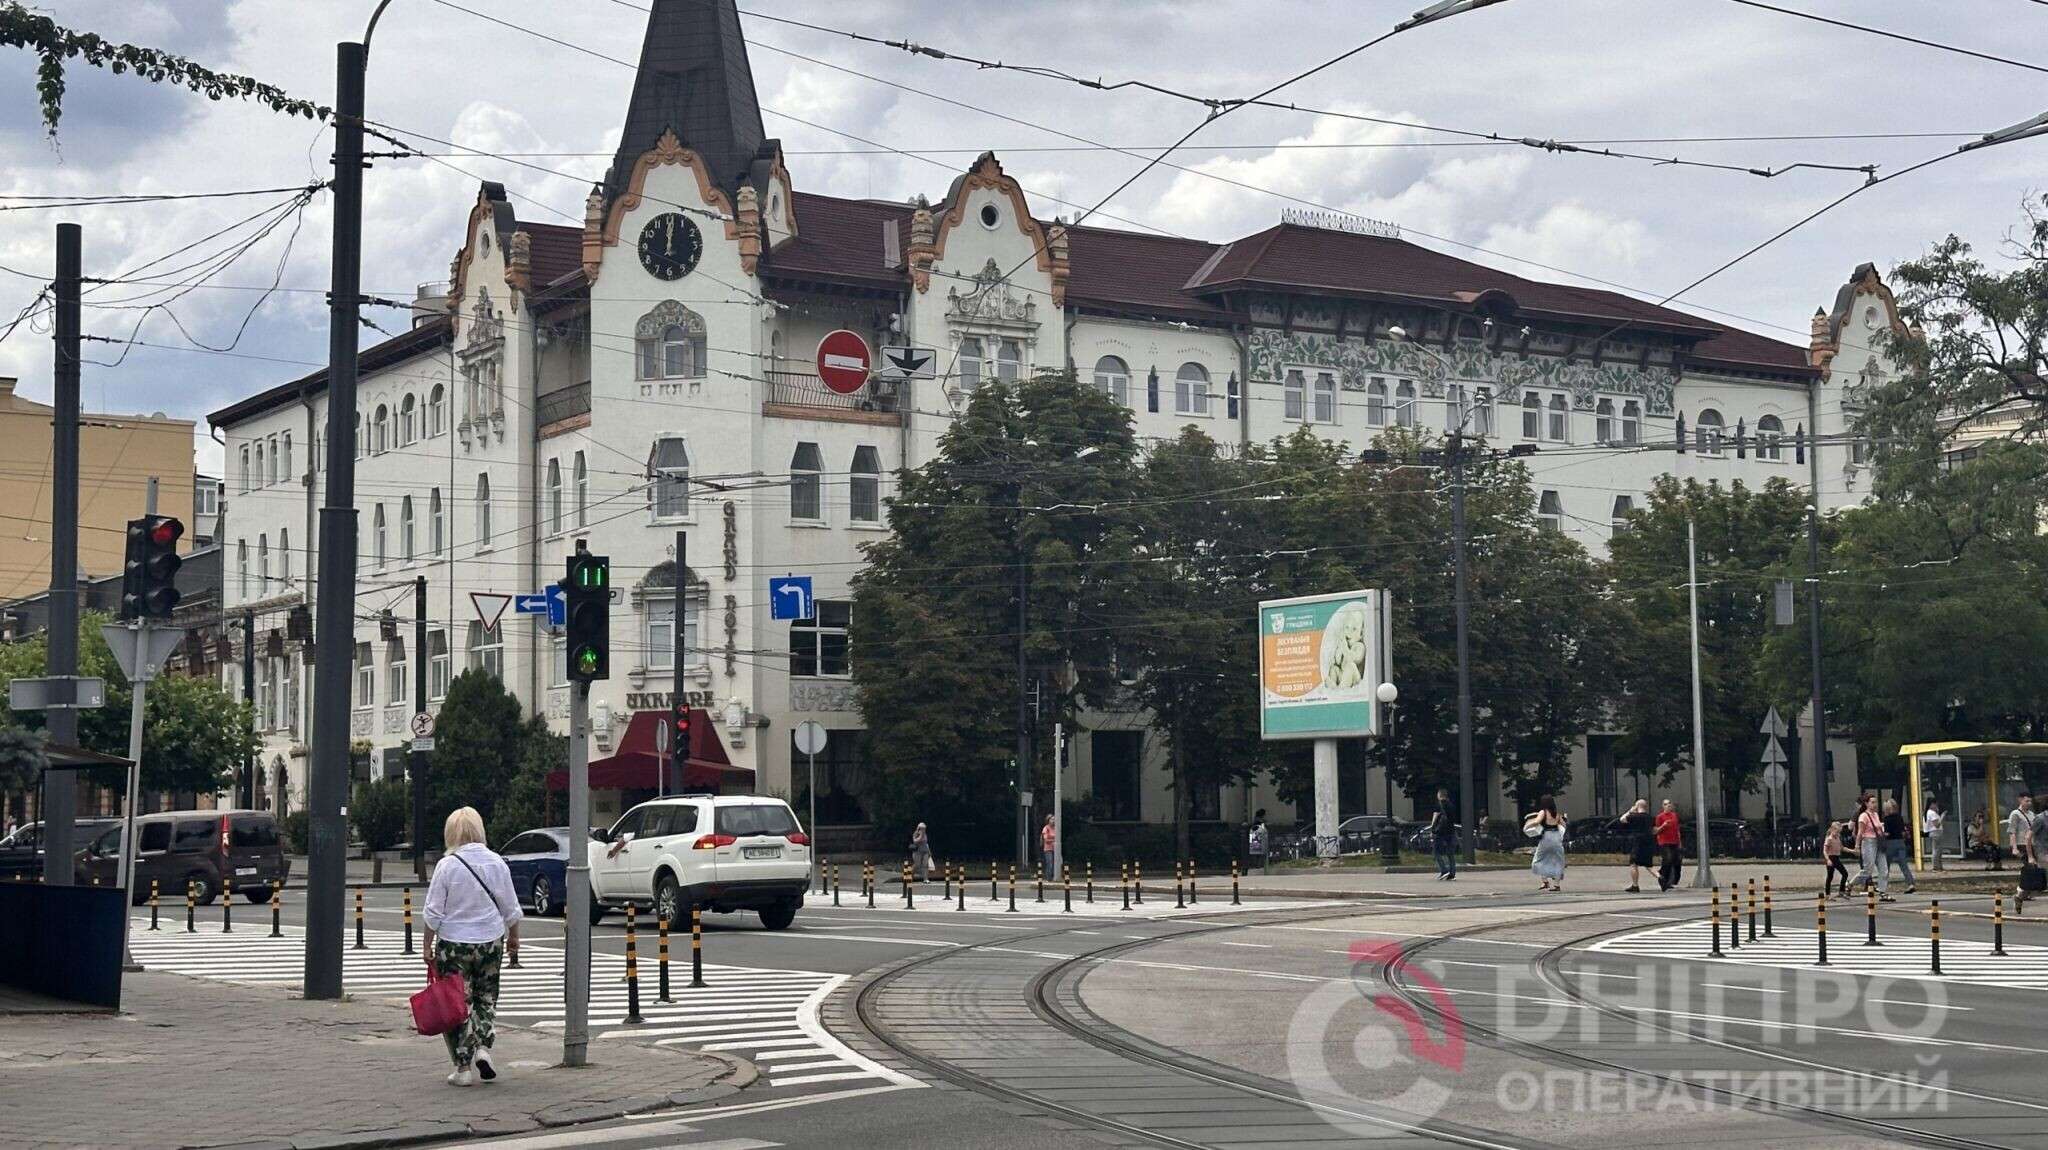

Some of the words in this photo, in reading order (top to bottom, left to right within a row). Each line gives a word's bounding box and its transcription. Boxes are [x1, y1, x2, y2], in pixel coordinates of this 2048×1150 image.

[655, 219, 661, 229] 11
[645, 230, 654, 238] 10
[689, 229, 695, 237] 2
[693, 241, 698, 250] 3
[645, 255, 651, 264] 8
[688, 254, 694, 262] 4
[655, 264, 660, 273] 7
[666, 267, 672, 276] 6
[680, 264, 686, 272] 5
[584, 567, 601, 586] 11
